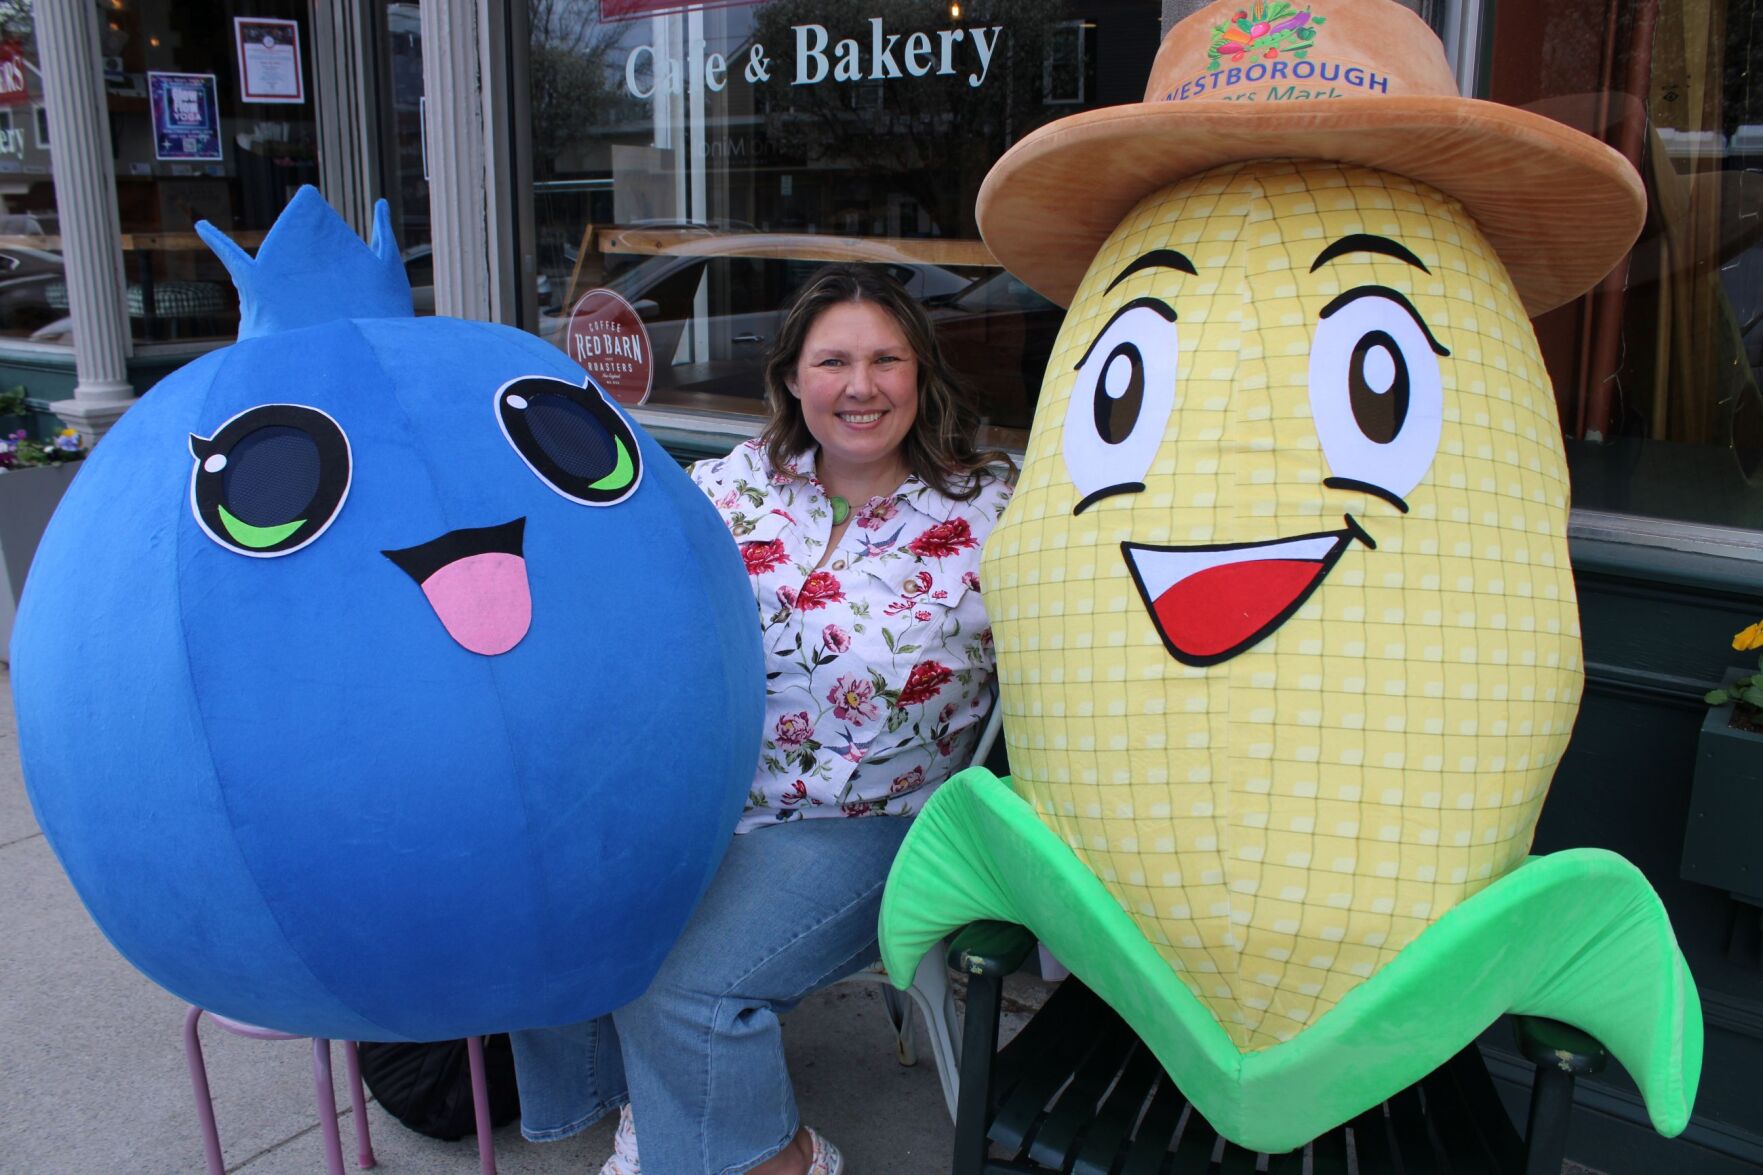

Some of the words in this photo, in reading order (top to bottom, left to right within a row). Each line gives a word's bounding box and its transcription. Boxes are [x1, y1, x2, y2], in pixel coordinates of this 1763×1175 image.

[744, 43, 771, 84] &
[790, 16, 1003, 88] Bakery
[589, 321, 621, 333] COFFEE
[575, 333, 601, 362] RED
[603, 334, 642, 364] BARN
[587, 361, 634, 373] ROASTERS
